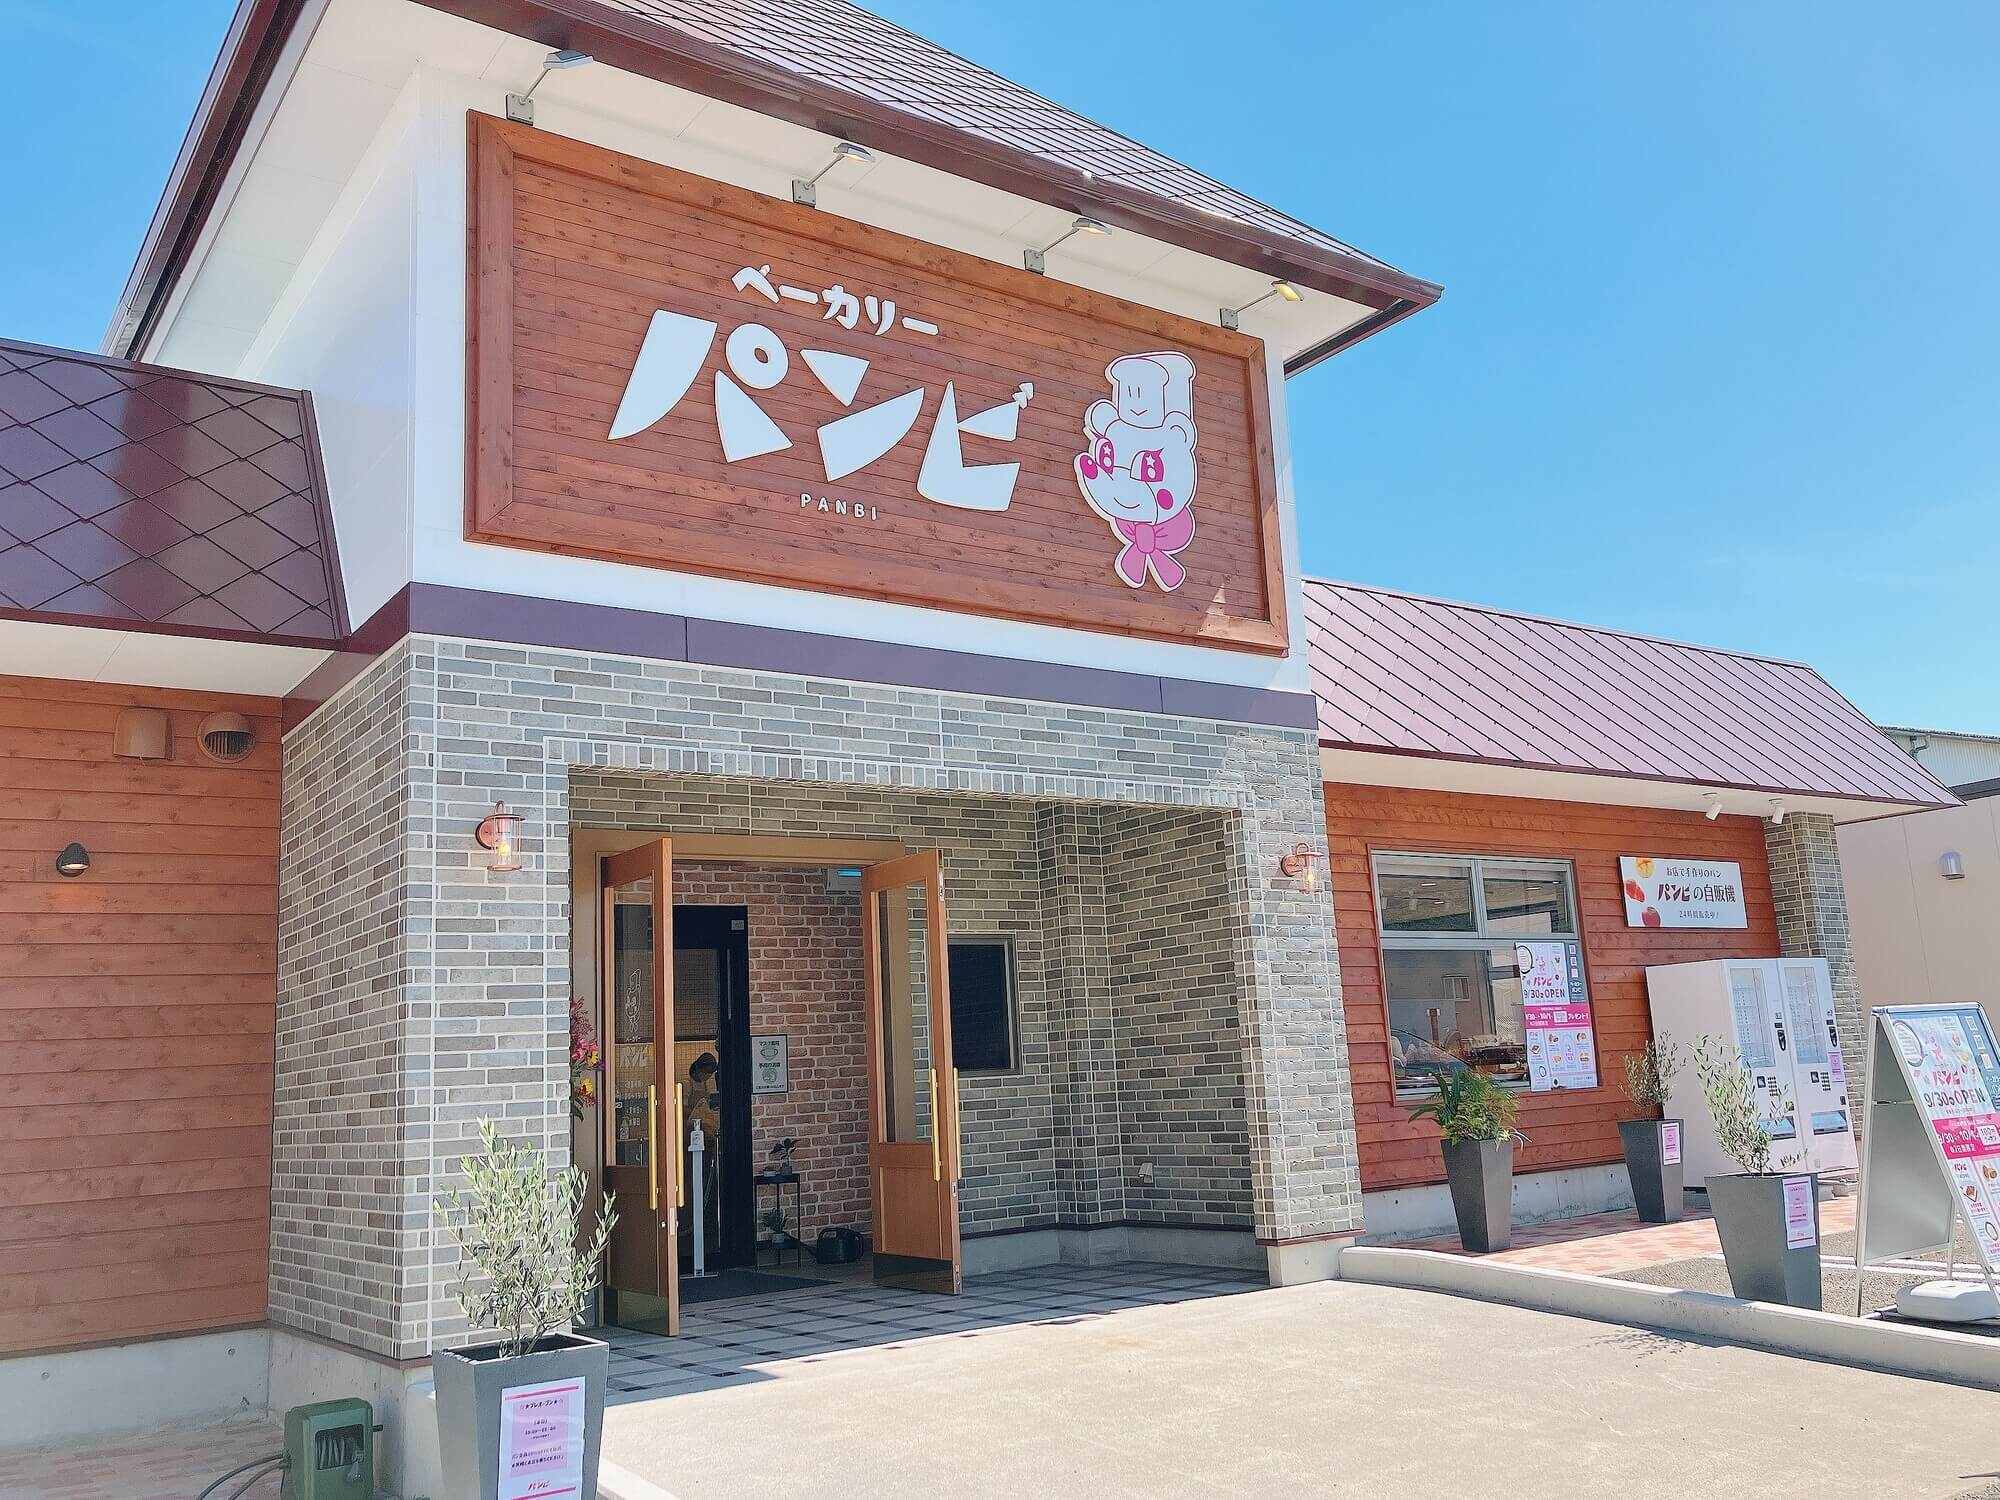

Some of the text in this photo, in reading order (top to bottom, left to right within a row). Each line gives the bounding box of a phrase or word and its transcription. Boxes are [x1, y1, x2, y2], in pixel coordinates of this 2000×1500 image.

[731, 264, 939, 336] ベーカリー
[607, 308, 1035, 512] パンビ
[800, 493, 878, 521] PANBI
[1666, 866, 1722, 878] お店で手作りのパン
[1657, 883, 1737, 903] パンビの自販機
[1544, 988, 1566, 998] OPEN
[1954, 1087, 1986, 1106] OPEN
